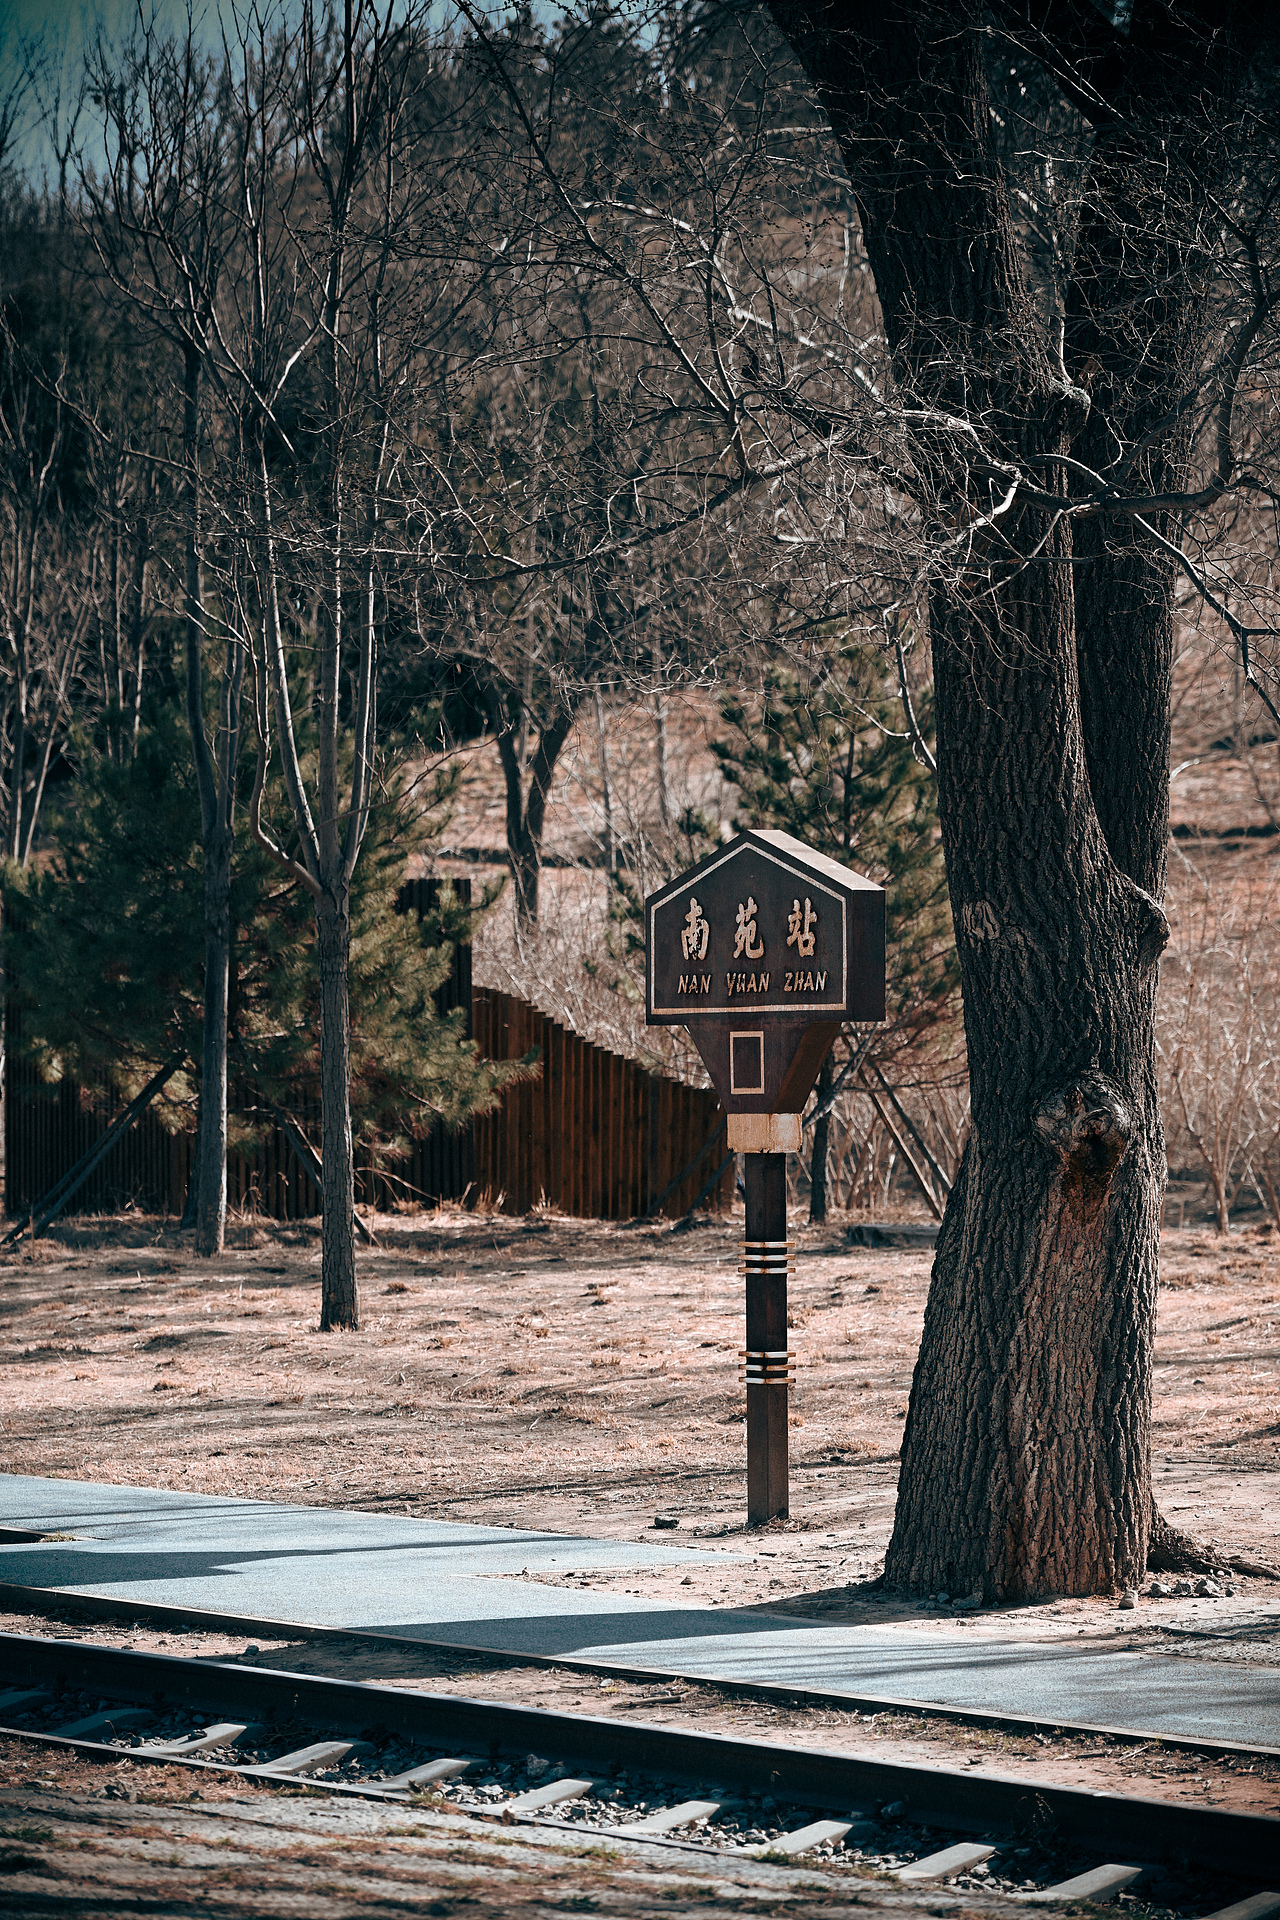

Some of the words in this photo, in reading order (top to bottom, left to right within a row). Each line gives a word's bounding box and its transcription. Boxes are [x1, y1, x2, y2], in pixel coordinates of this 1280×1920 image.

[681, 896, 818, 960] 南苑站
[677, 974, 712, 994] NAN
[726, 971, 770, 996] YUAN
[783, 970, 828, 992] ZHAN
